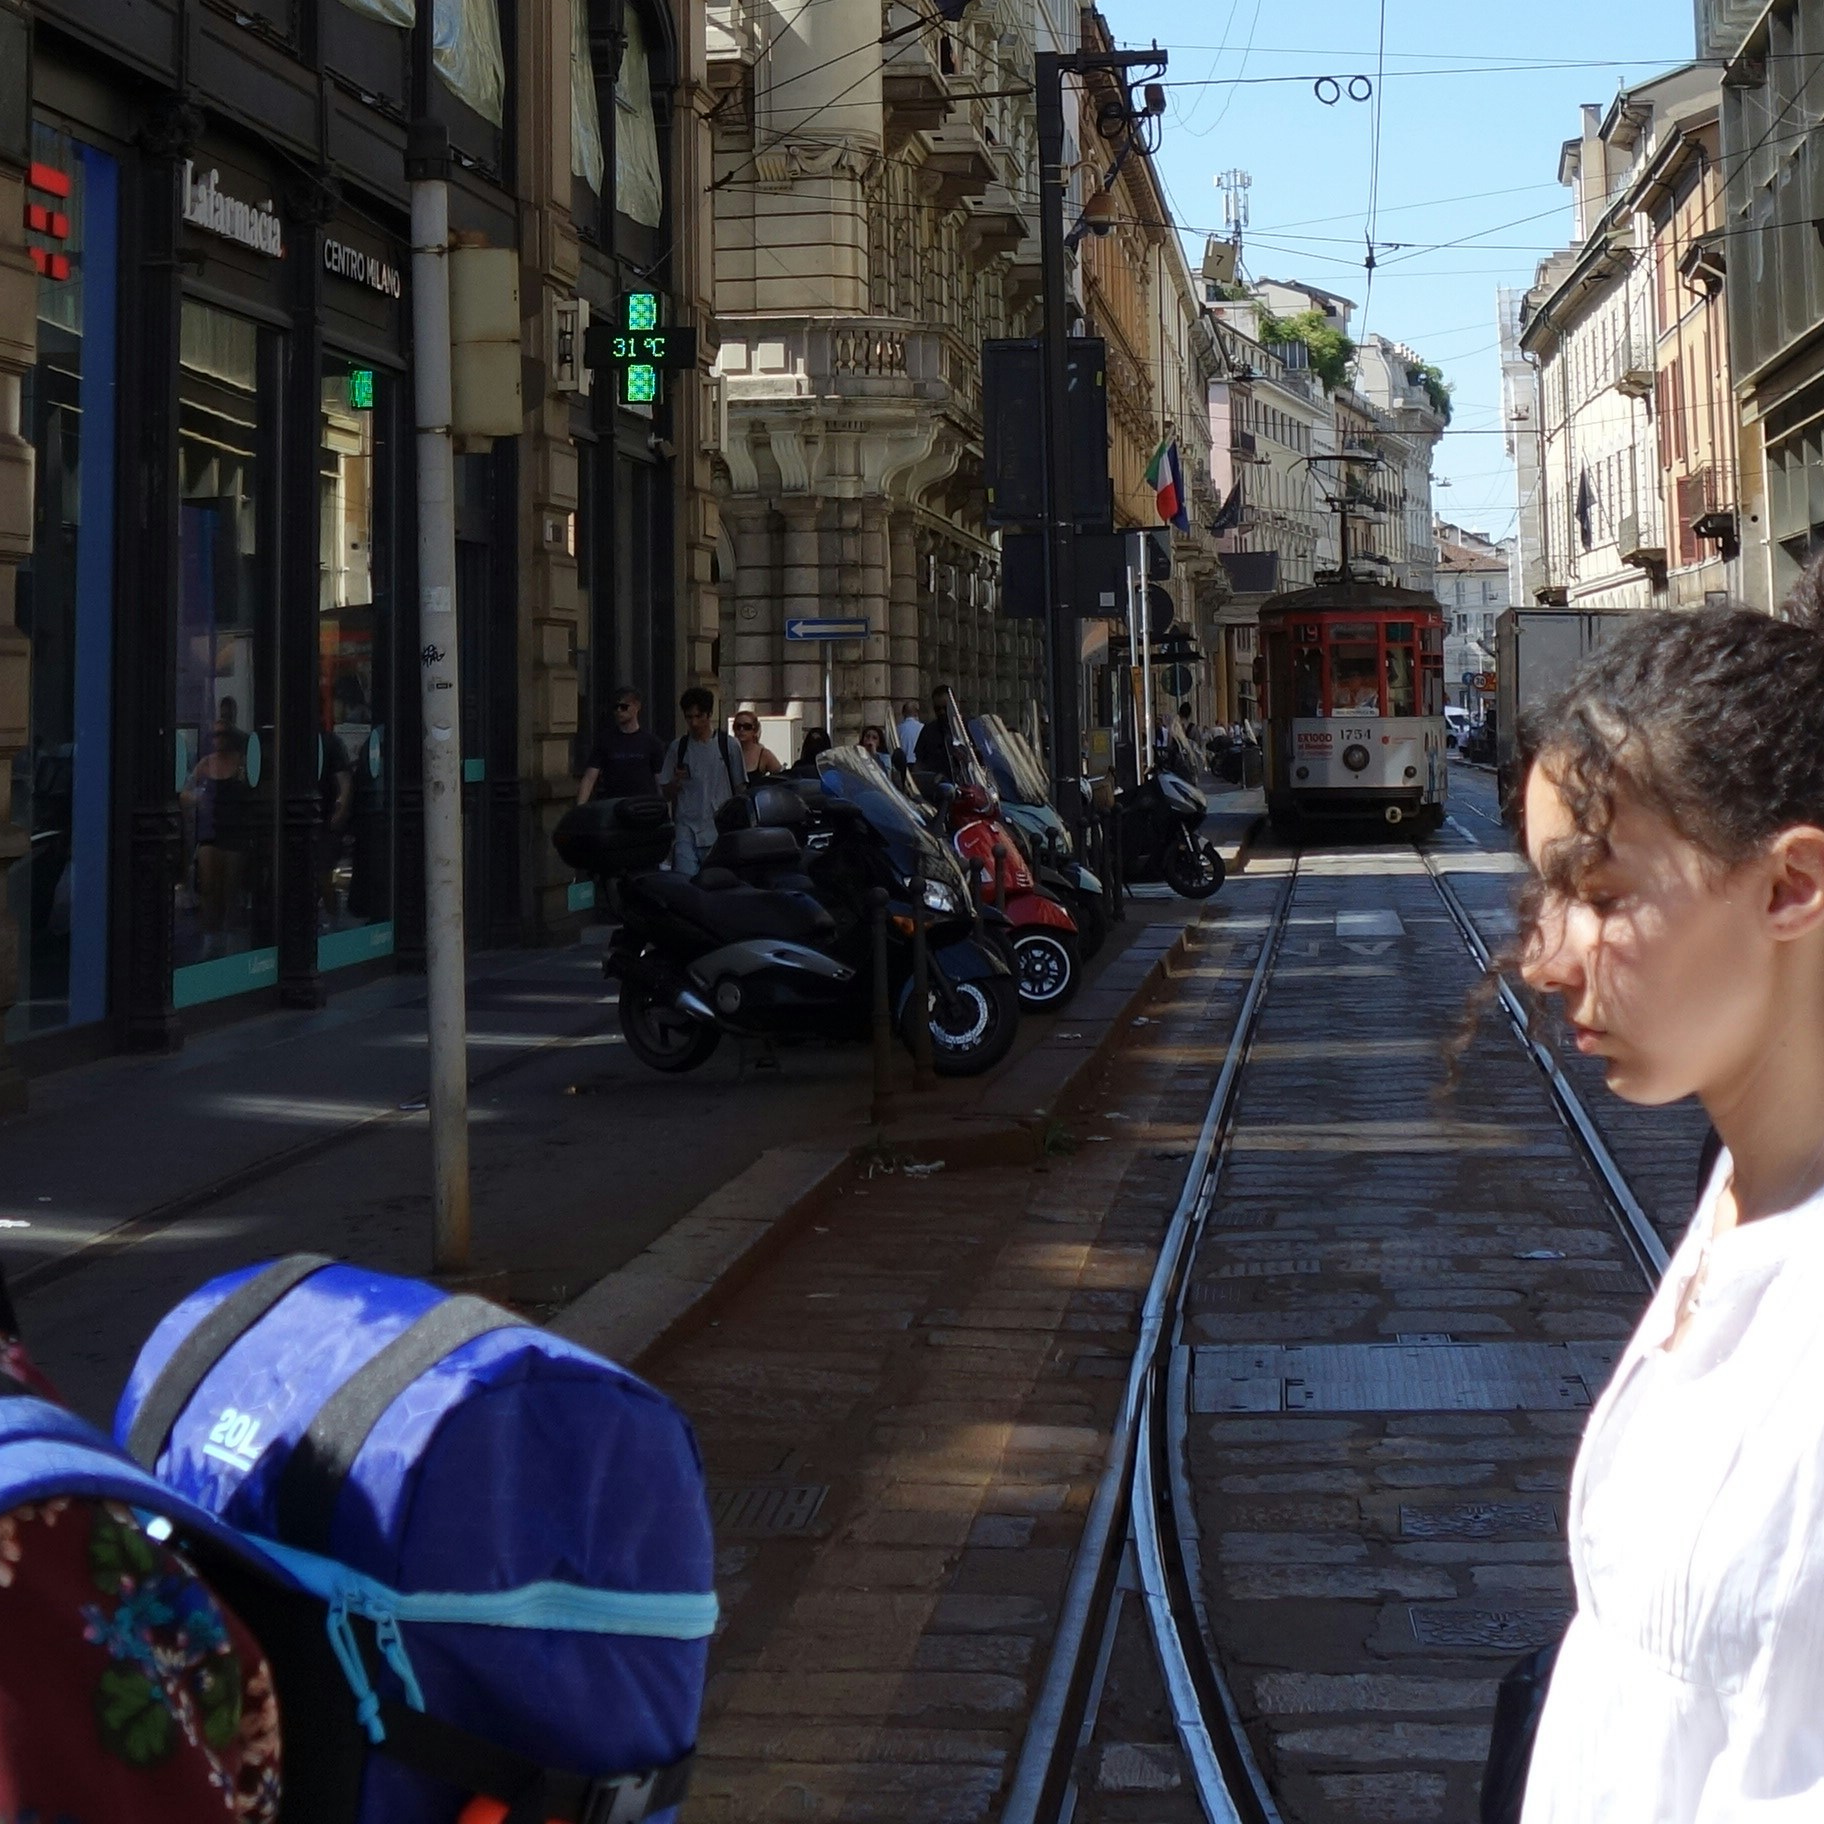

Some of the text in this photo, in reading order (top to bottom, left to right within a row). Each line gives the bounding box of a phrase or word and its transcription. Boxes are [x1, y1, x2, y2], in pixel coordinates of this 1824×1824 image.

[324, 238, 401, 299] CENTRO MILANO
[1217, 254, 1224, 266] 7
[613, 337, 636, 357] 31
[1300, 624, 1319, 642] 19
[1340, 729, 1371, 741] 1754
[209, 1407, 260, 1460] 20L
